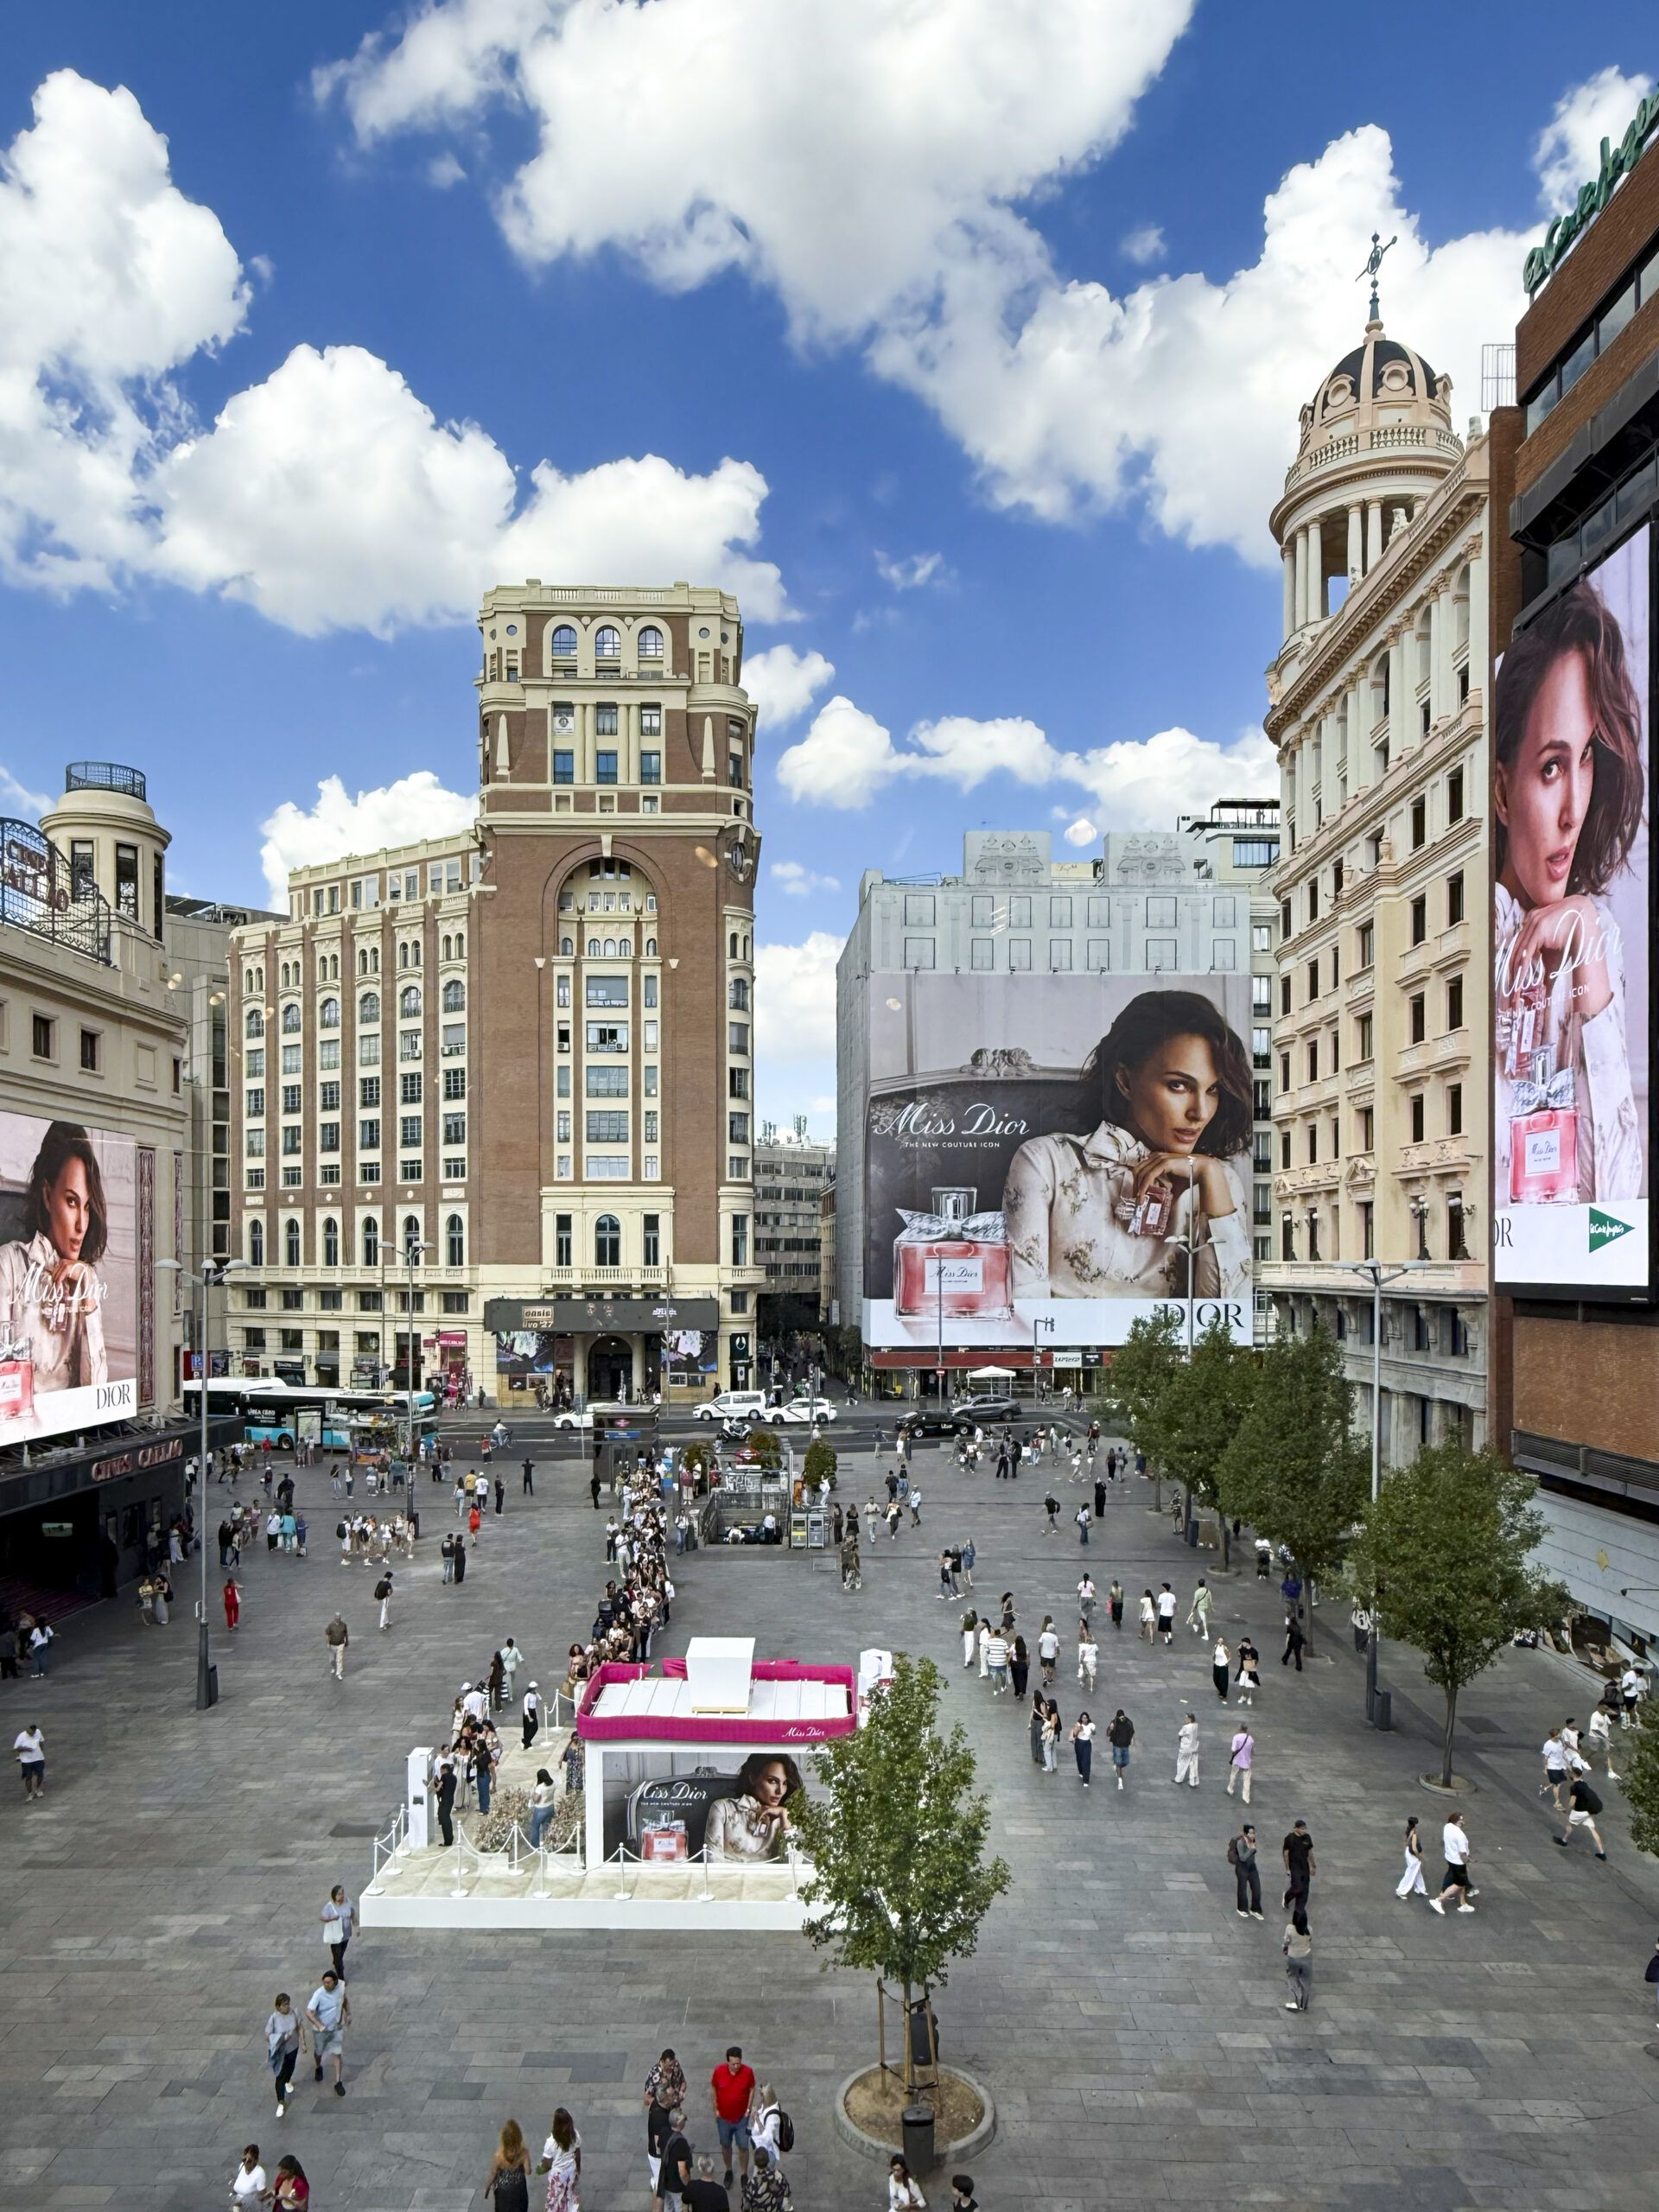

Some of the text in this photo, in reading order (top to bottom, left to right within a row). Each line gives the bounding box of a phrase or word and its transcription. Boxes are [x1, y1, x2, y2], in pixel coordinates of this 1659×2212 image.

[1549, 909, 1624, 979] Dior
[873, 1102, 1030, 1135] Miss Dior
[7, 1261, 63, 1305] Miss
[524, 1308, 550, 1317] oasis
[1160, 1302, 1245, 1328] DOR
[97, 1382, 131, 1410] DIOR
[781, 1726, 825, 1738] Miss Dior
[624, 1780, 708, 1800] Miss Dior
